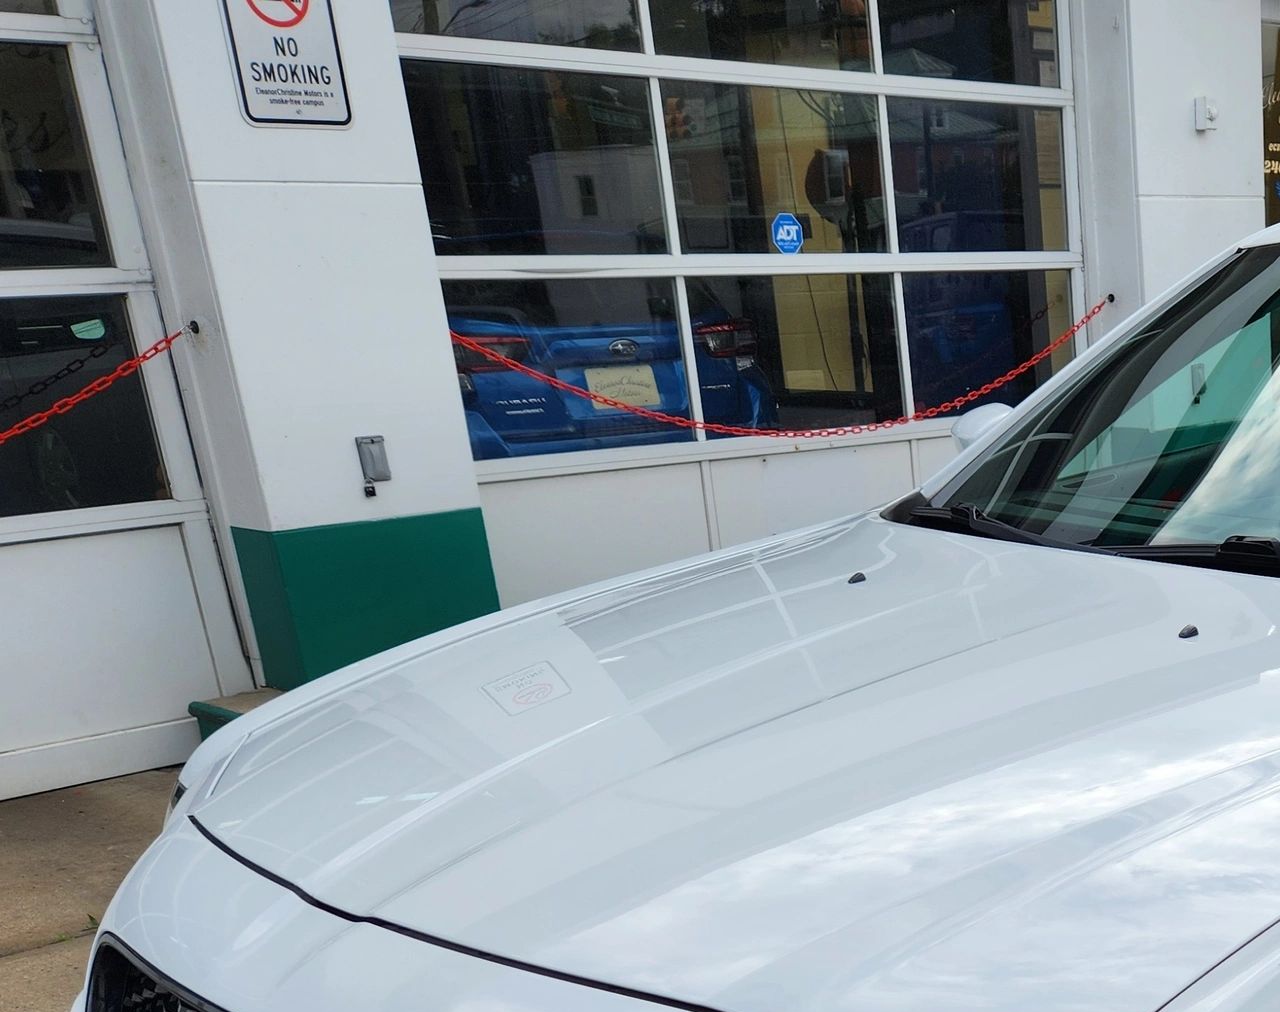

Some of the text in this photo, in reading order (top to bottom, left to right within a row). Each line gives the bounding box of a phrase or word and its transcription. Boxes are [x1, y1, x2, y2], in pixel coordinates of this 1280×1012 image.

[273, 36, 298, 57] NO
[250, 62, 331, 85] SMOKING
[776, 225, 799, 241] ADT
